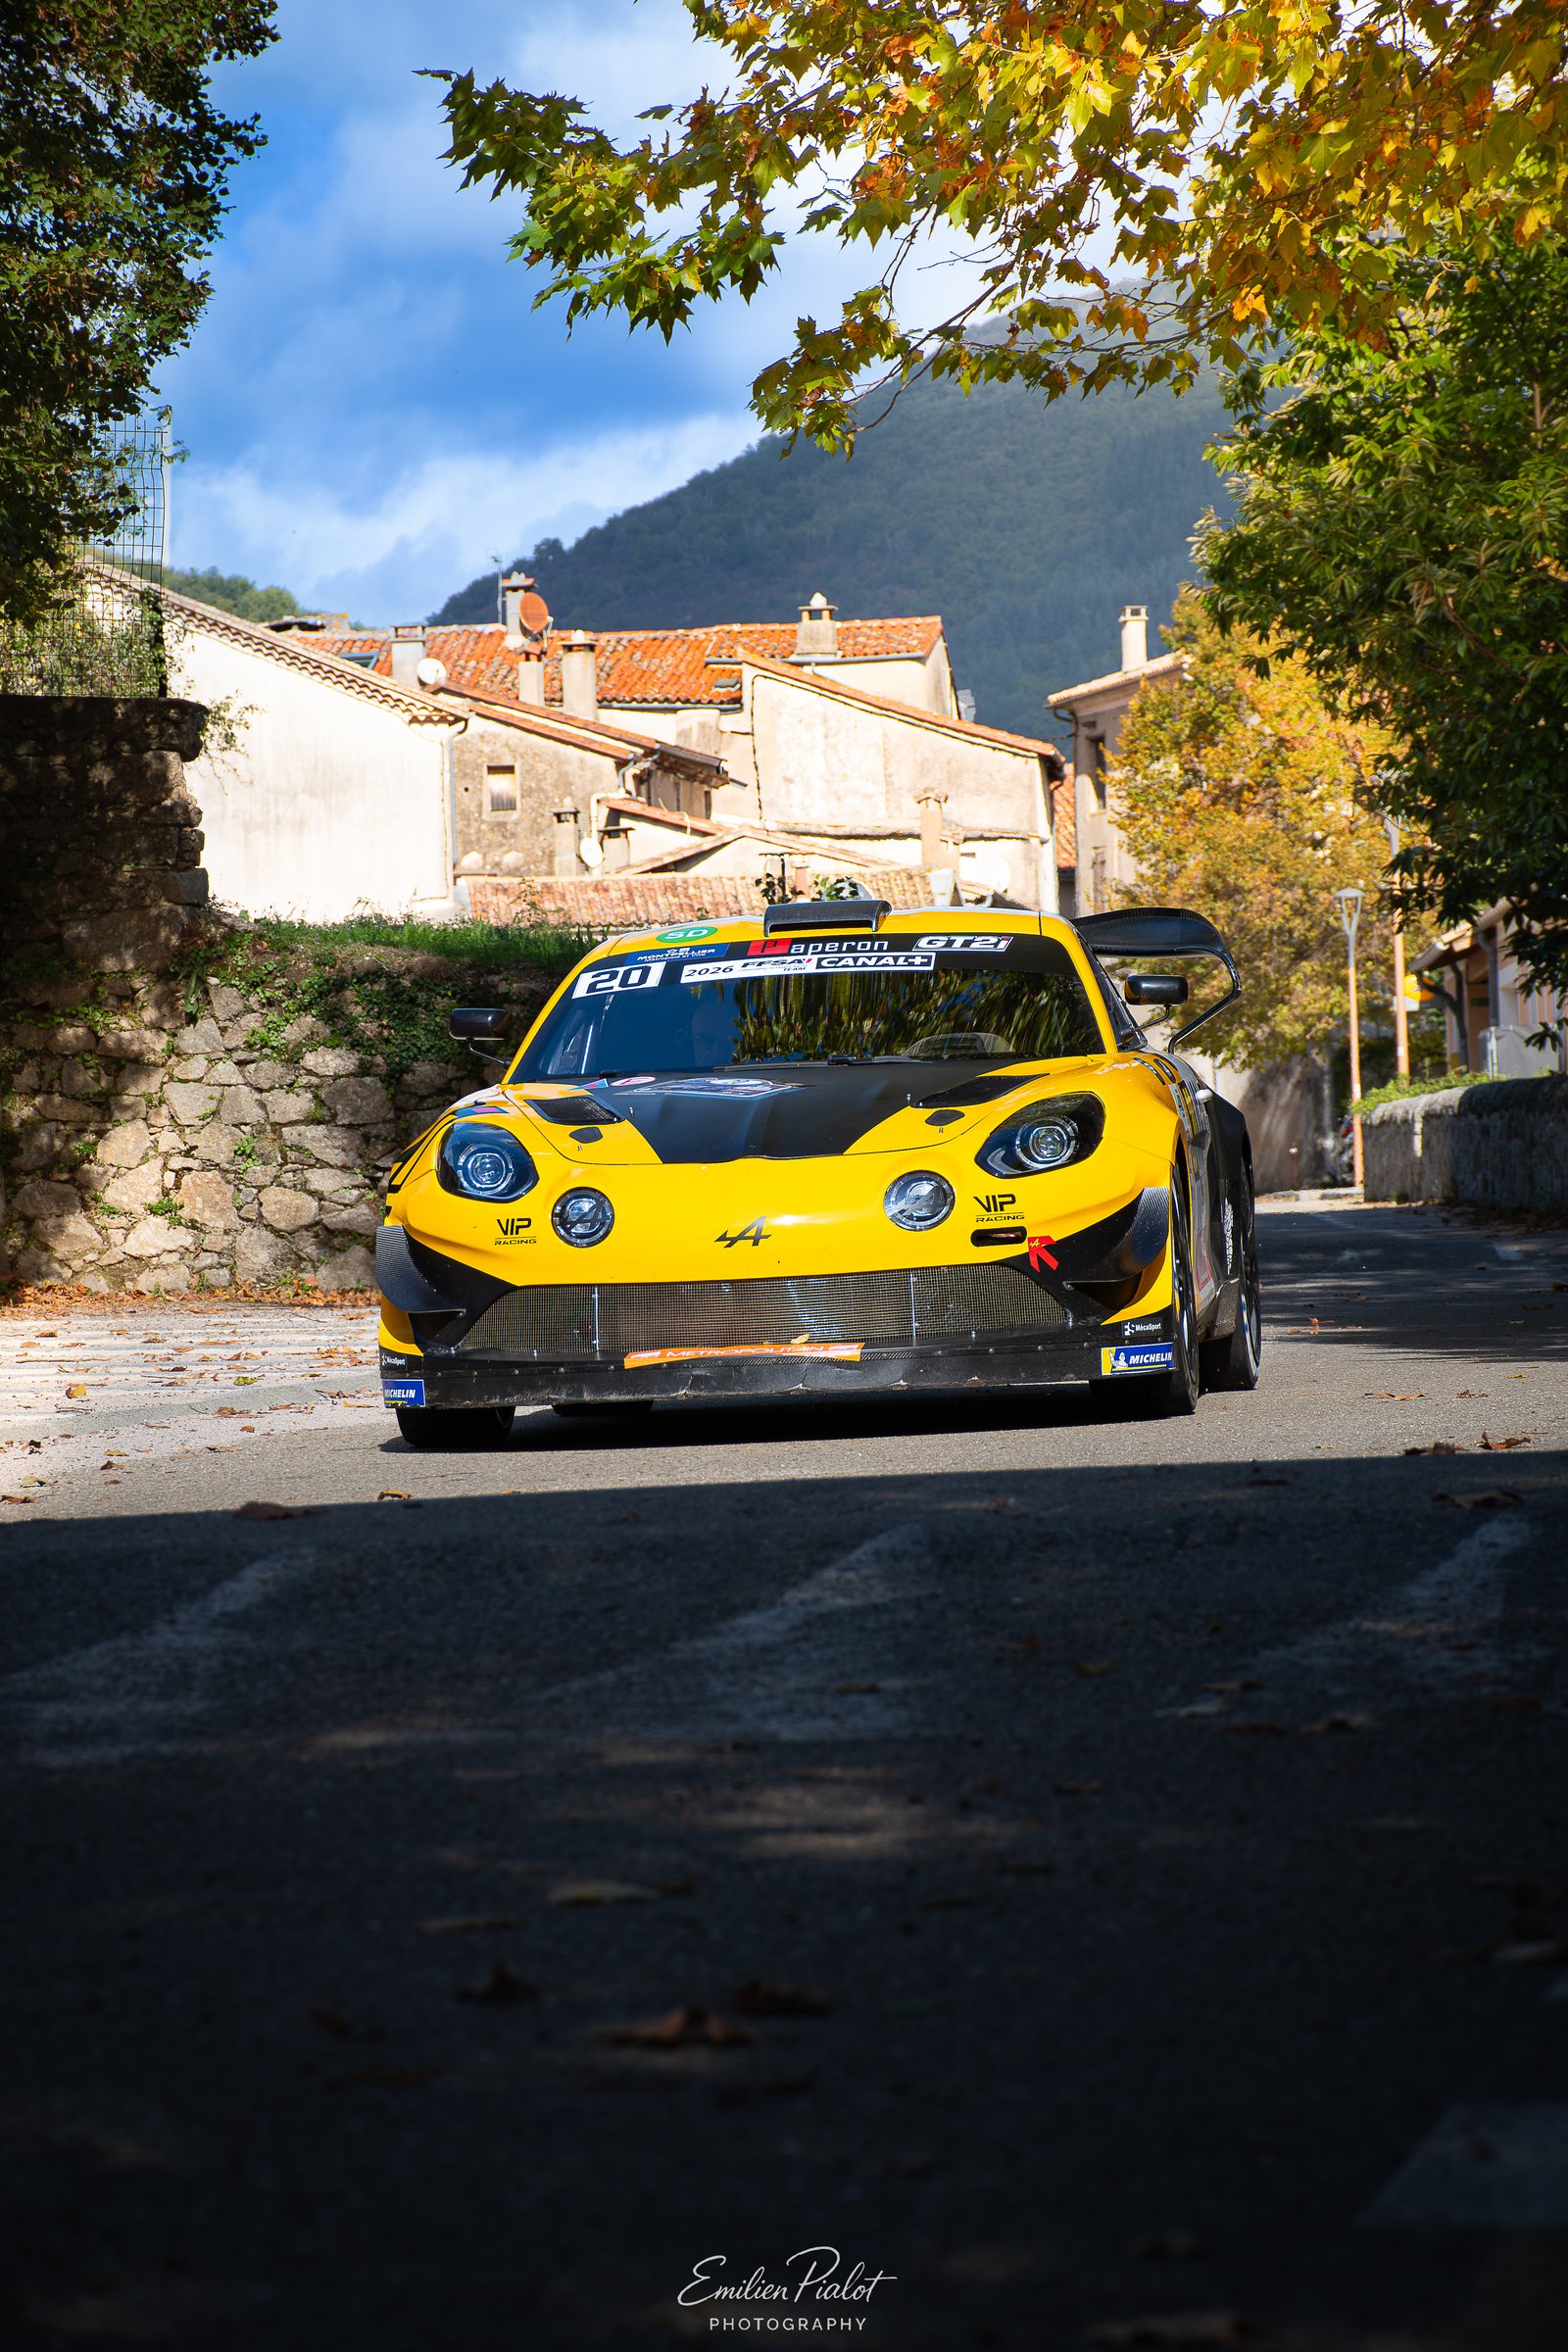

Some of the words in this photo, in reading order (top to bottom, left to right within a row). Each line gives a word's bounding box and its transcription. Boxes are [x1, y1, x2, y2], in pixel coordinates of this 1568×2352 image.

[664, 929, 709, 940] SD
[760, 940, 889, 956] Paperon
[918, 936, 1011, 949] GT2i
[636, 949, 716, 961] MONTPELLIER
[820, 956, 929, 967] CANAL+
[685, 965, 735, 978] 2026
[585, 964, 653, 995] 20
[973, 1193, 1017, 1213] VIP
[976, 1214, 1025, 1223] RACING
[497, 1217, 532, 1236] VIP
[665, 1346, 824, 1358] METROPOLITAIN
[1128, 1351, 1173, 1365] MICHELIN
